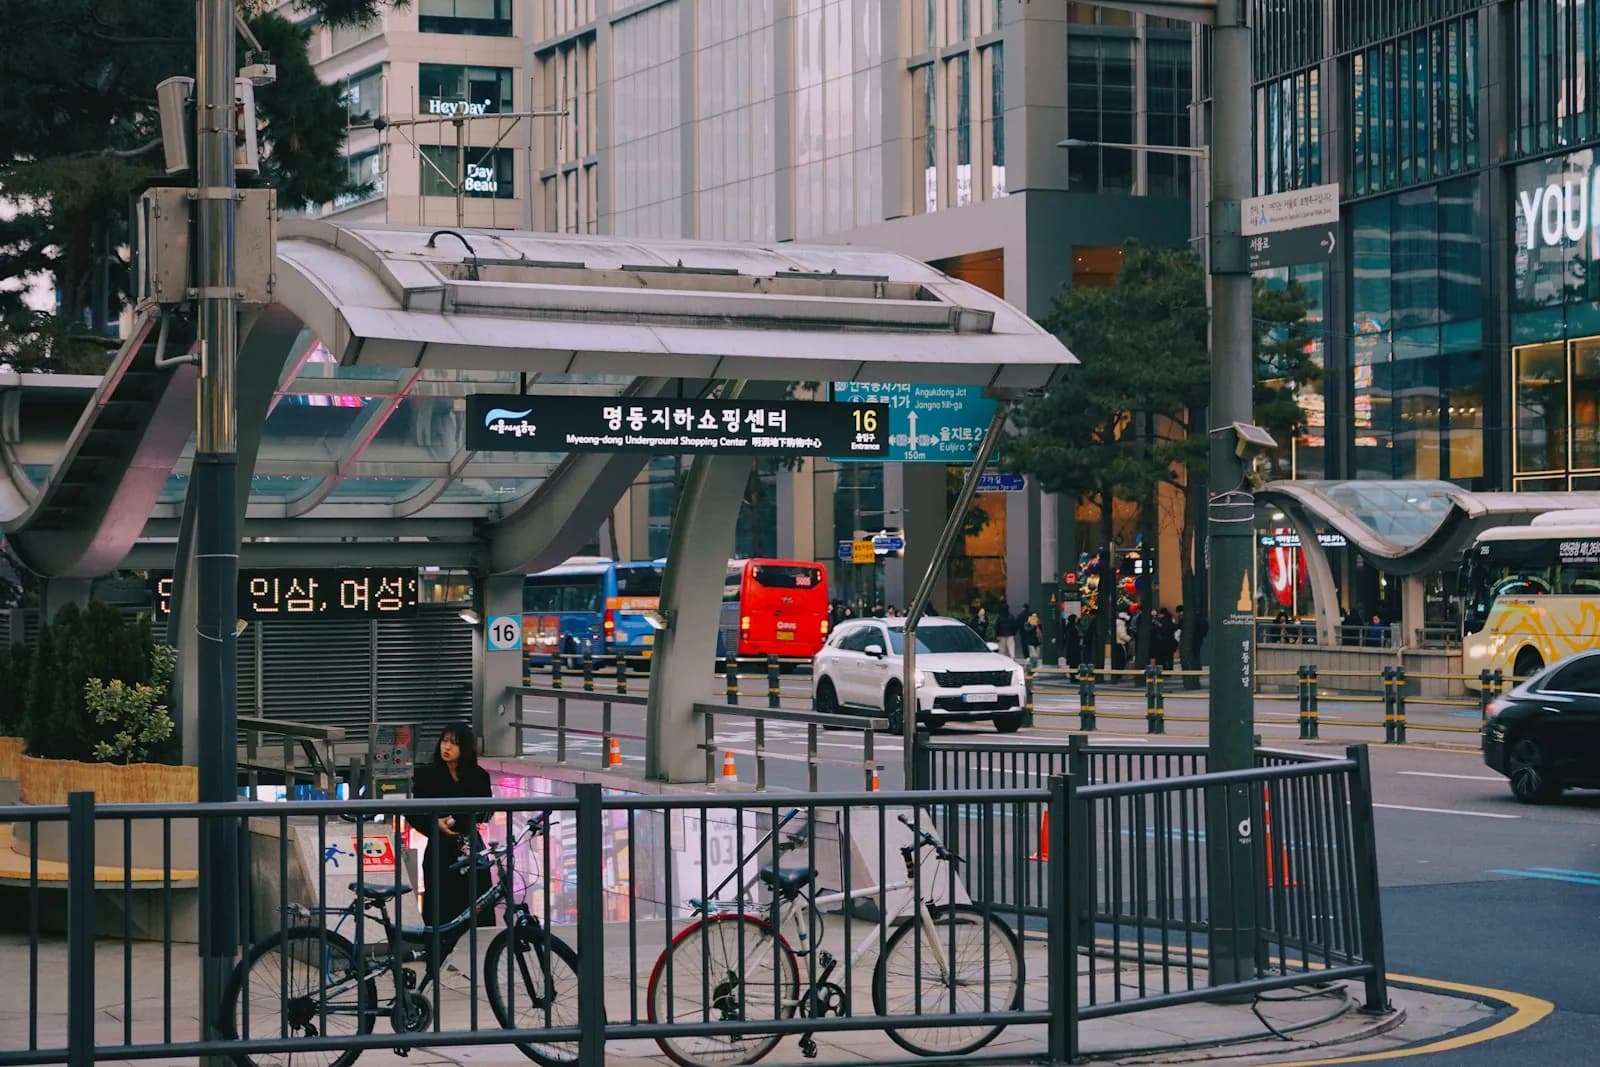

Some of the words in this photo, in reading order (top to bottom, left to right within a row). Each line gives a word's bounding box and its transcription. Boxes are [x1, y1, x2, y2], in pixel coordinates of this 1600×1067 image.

[467, 164, 493, 181] Day
[1250, 237, 1270, 252] 서울로
[603, 406, 787, 433] 명동지하쇼핑센터
[852, 409, 878, 432] 16
[566, 434, 623, 446] Myeong-dong
[625, 435, 679, 446] Underground
[680, 436, 718, 447] Shopping
[719, 437, 748, 447] Center
[250, 577, 327, 612] 인삼,
[493, 624, 514, 642] 16
